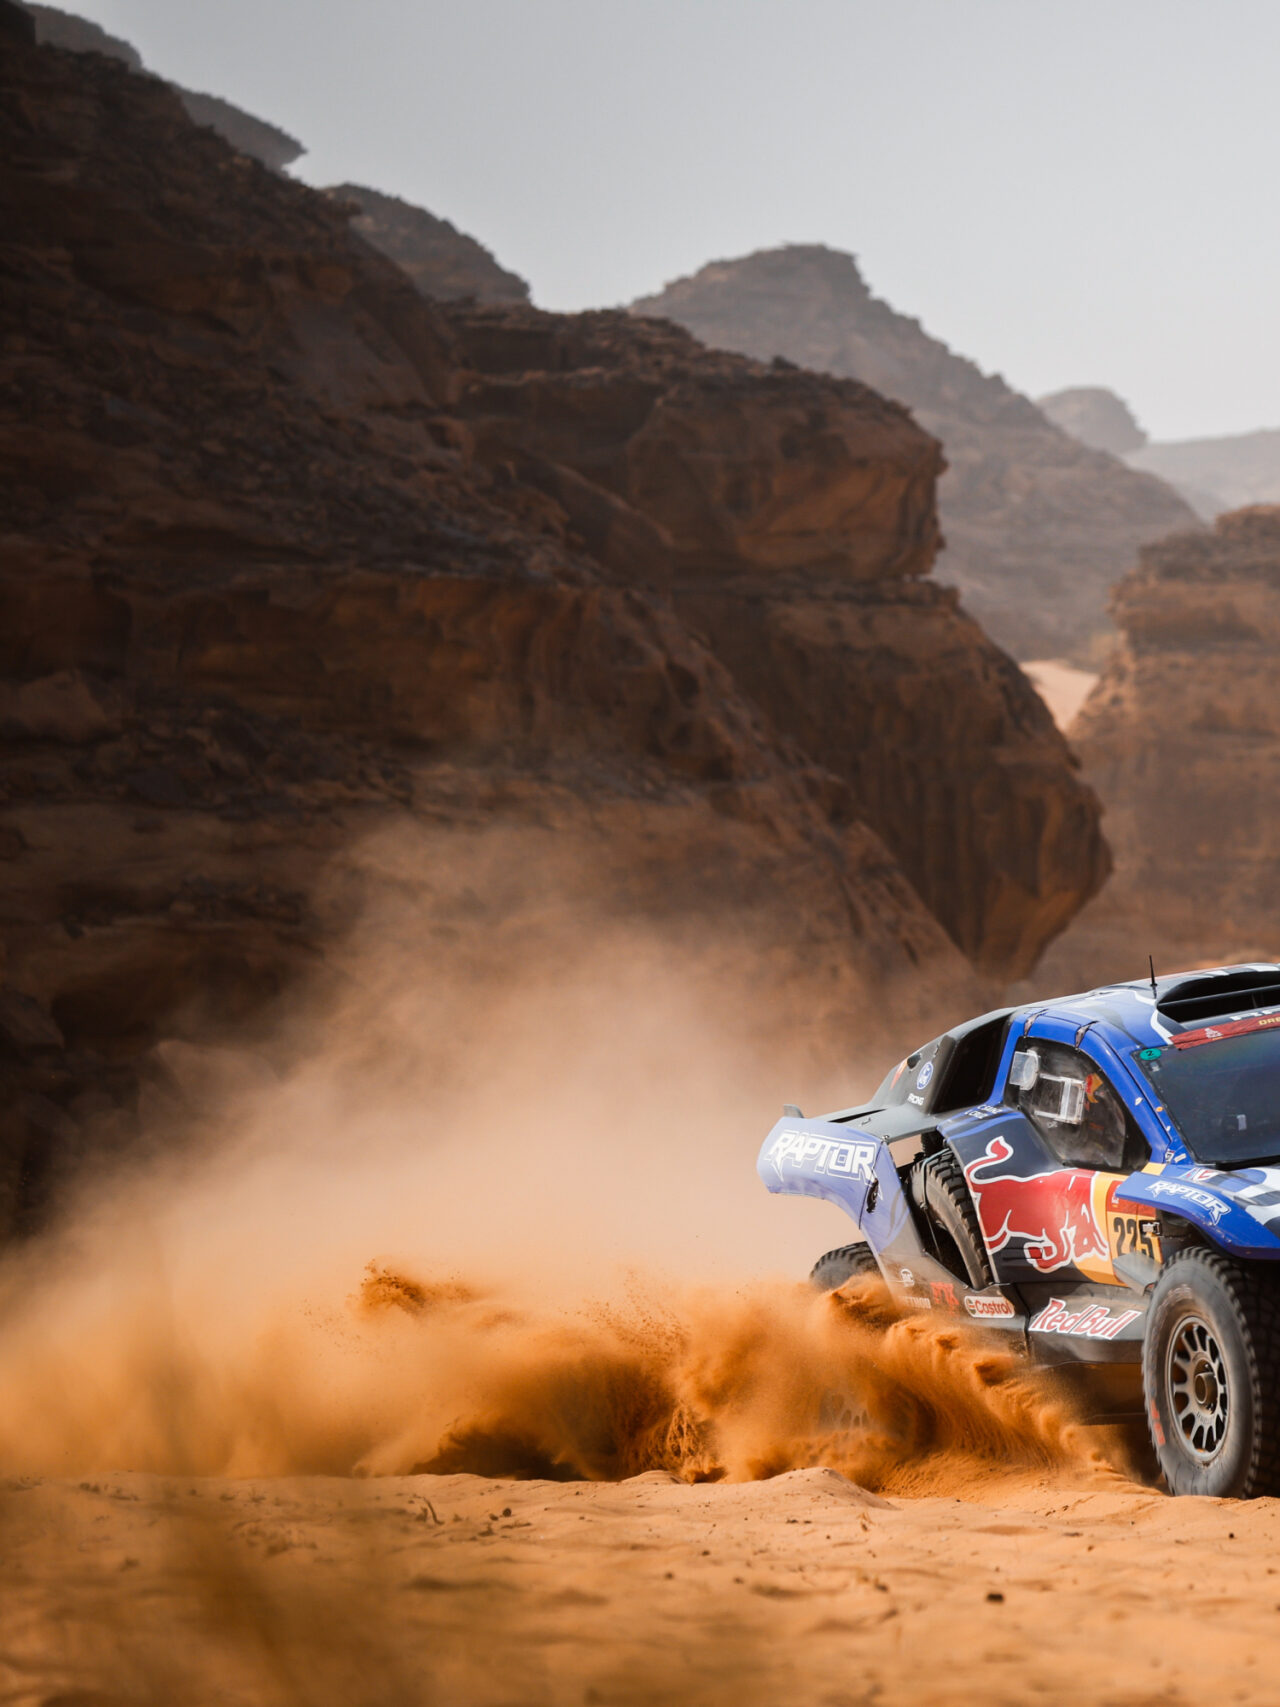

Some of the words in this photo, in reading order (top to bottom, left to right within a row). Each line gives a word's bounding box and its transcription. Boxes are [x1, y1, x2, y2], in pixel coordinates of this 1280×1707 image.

[765, 1130, 877, 1184] RAPTOR
[1145, 1180, 1231, 1225] RAPTOR
[1113, 1216, 1155, 1260] 225
[975, 1298, 1012, 1316] Castrol
[1029, 1297, 1096, 1334] Red
[1070, 1304, 1142, 1340] Bull
